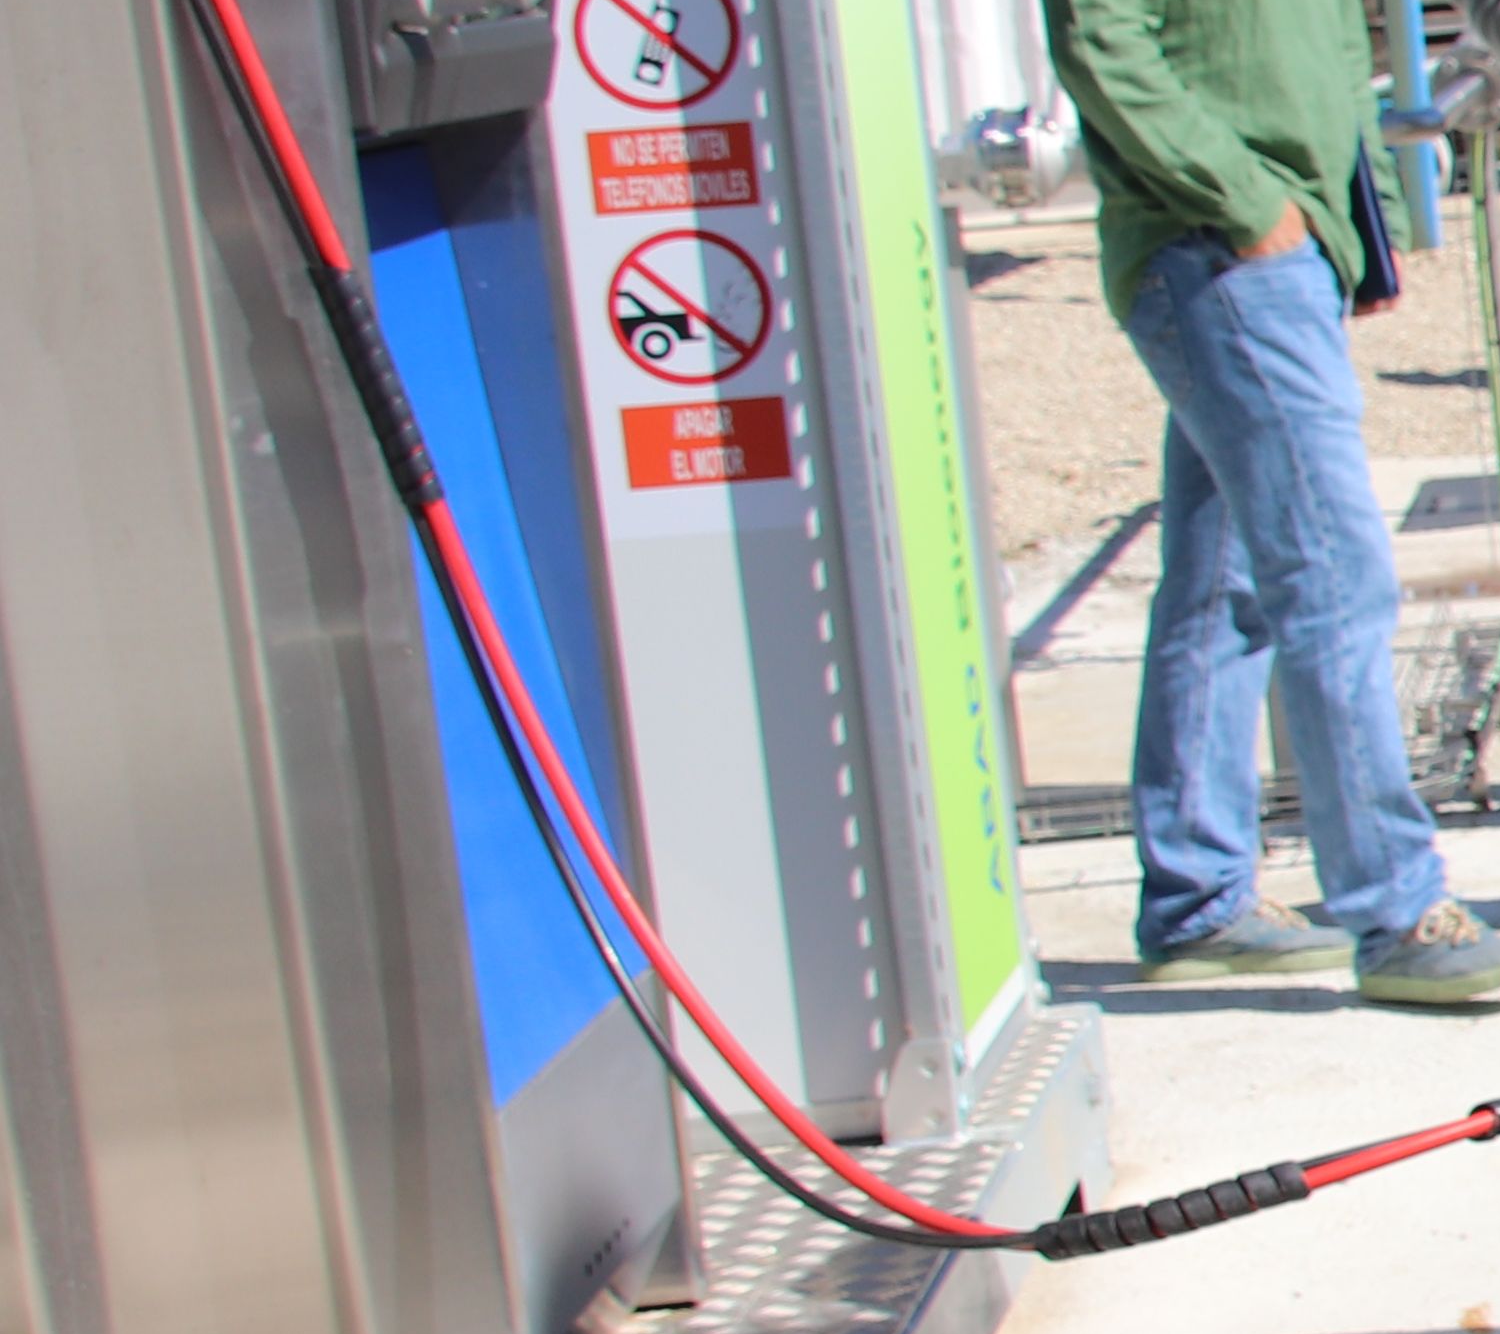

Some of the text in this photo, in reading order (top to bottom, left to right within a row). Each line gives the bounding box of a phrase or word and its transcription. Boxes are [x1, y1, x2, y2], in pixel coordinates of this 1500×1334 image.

[611, 129, 731, 166] NO SE PERMITEN
[674, 406, 734, 440] APAGAR
[671, 445, 747, 481] EL MOTOR
